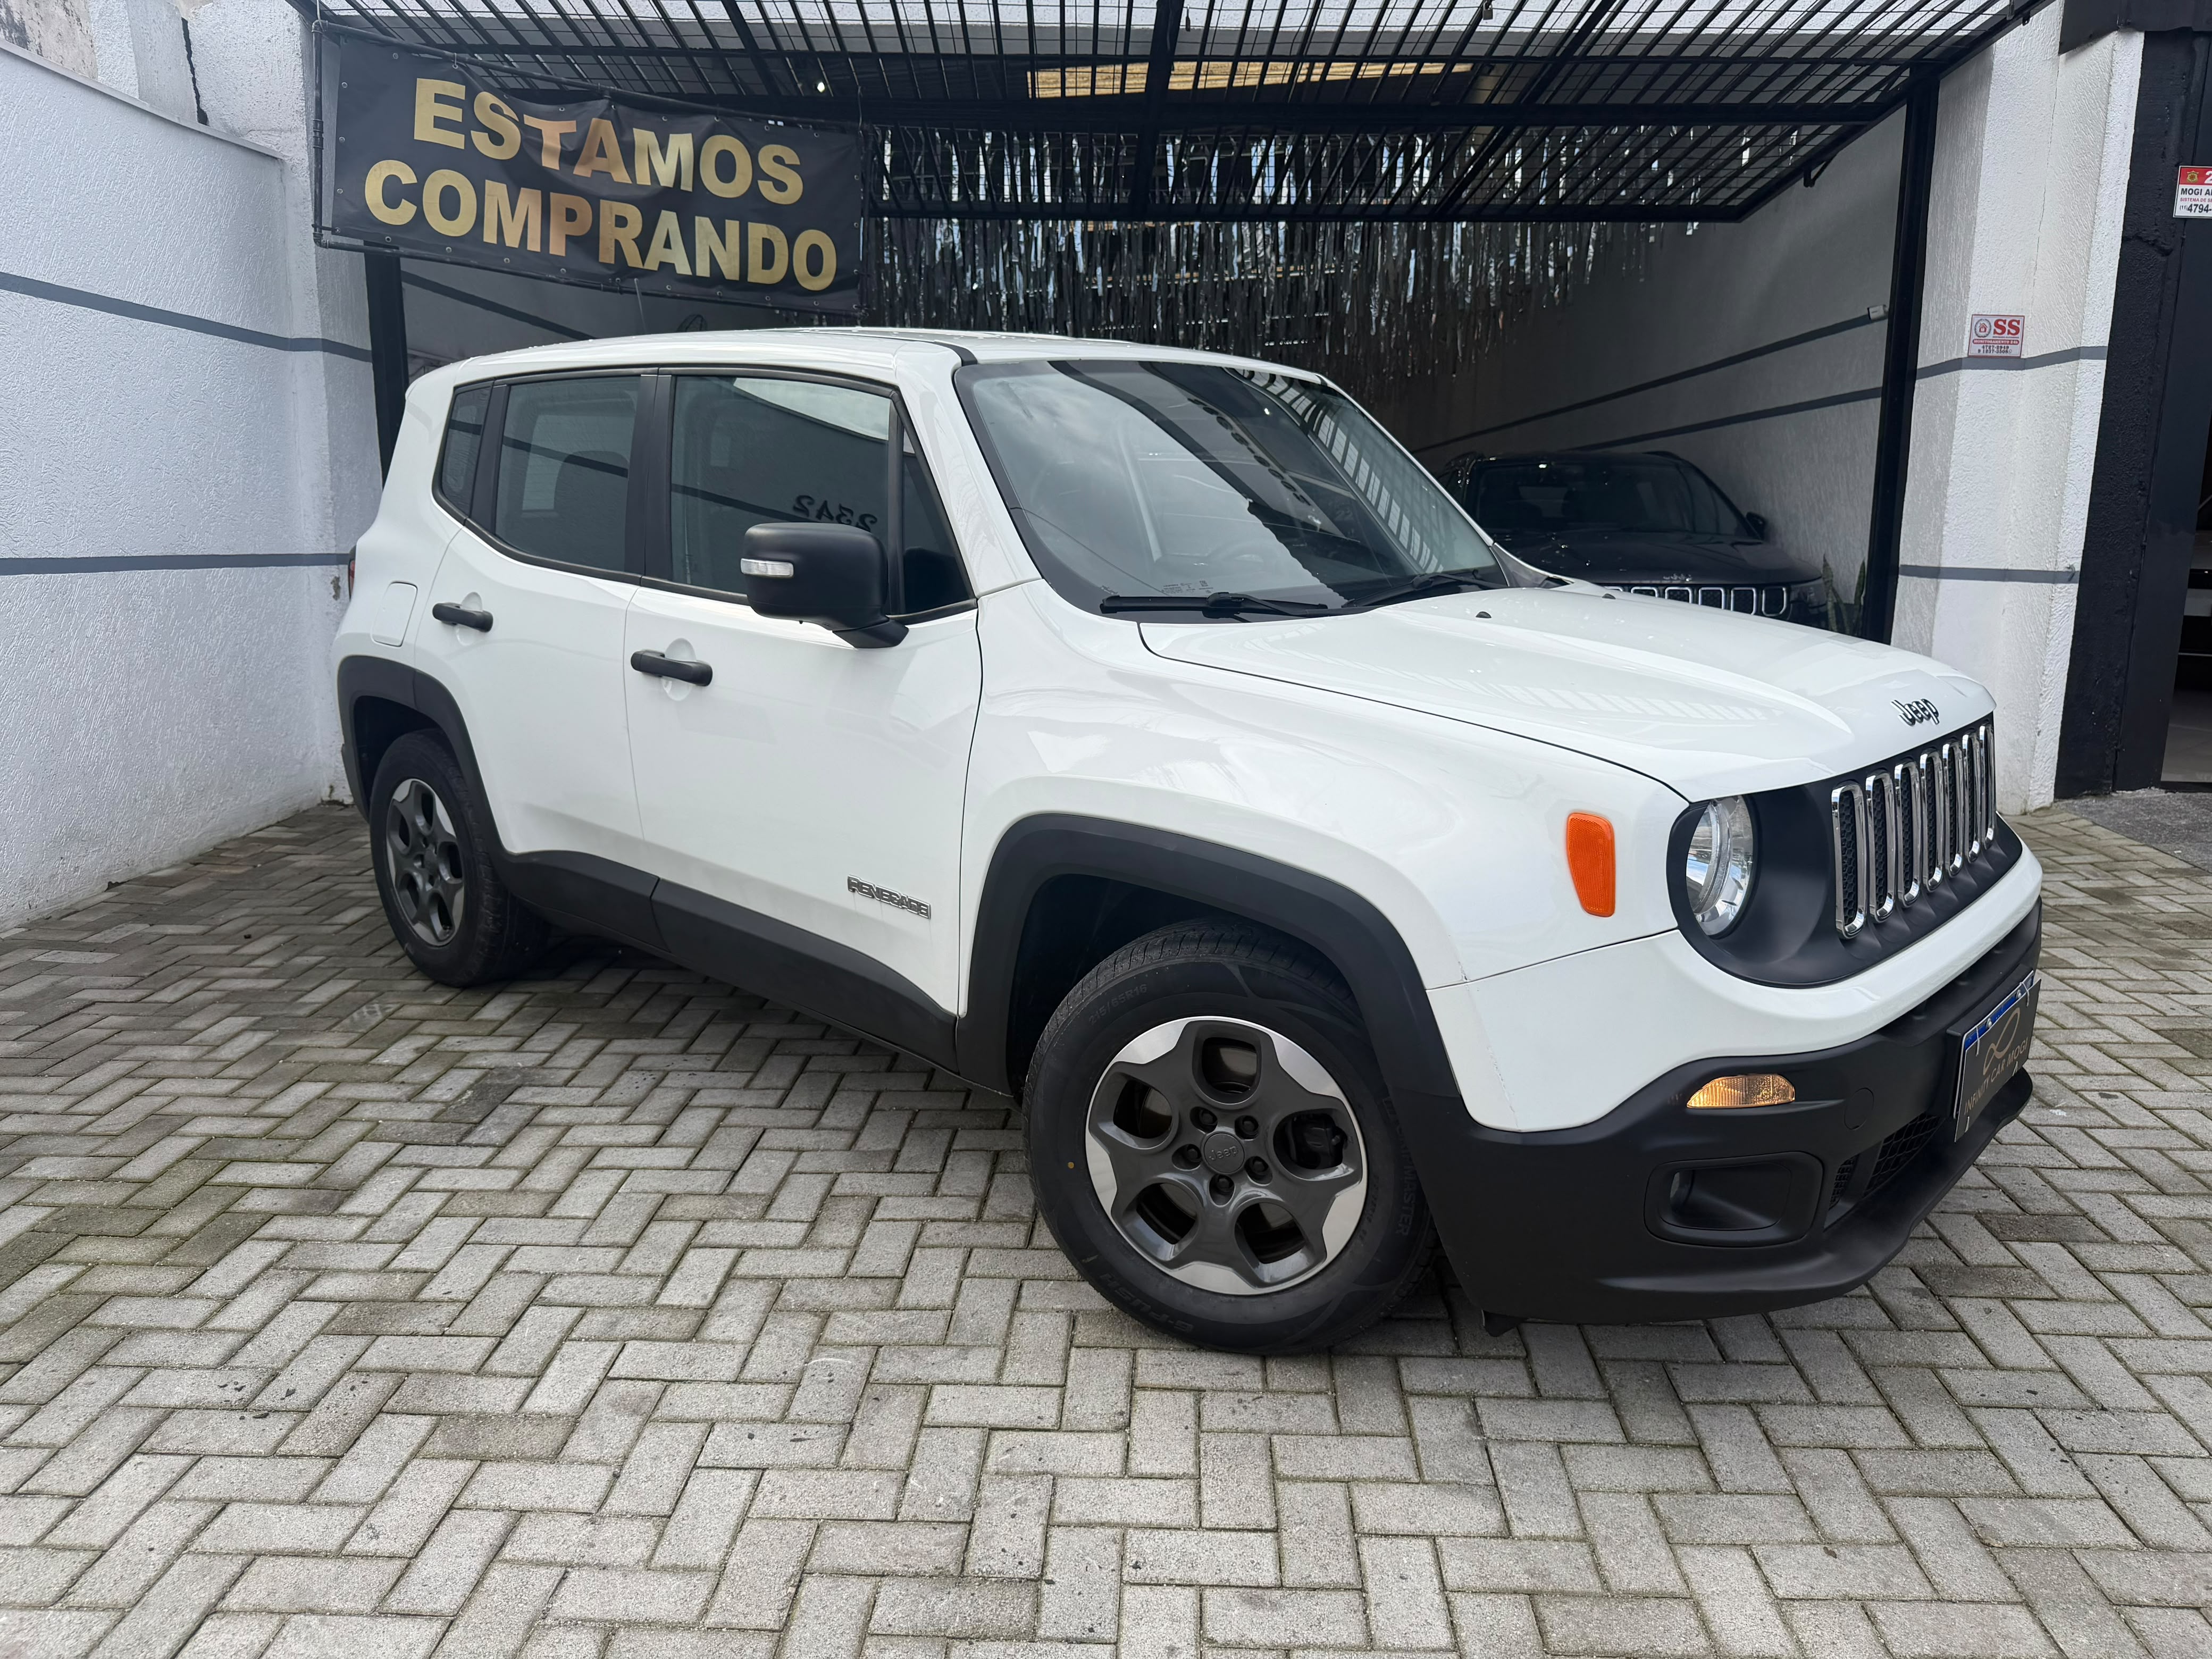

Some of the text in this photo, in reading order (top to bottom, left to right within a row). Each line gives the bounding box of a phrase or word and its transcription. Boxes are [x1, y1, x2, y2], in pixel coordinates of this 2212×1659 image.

[413, 77, 805, 206] ESTAMOS
[364, 159, 838, 292] COMPRANDO
[1993, 319, 2021, 336] SS
[1890, 698, 1940, 727] Jeep
[847, 874, 932, 920] RENEGADE
[1964, 1036, 2028, 1116] INFINITY CAR MOGI
